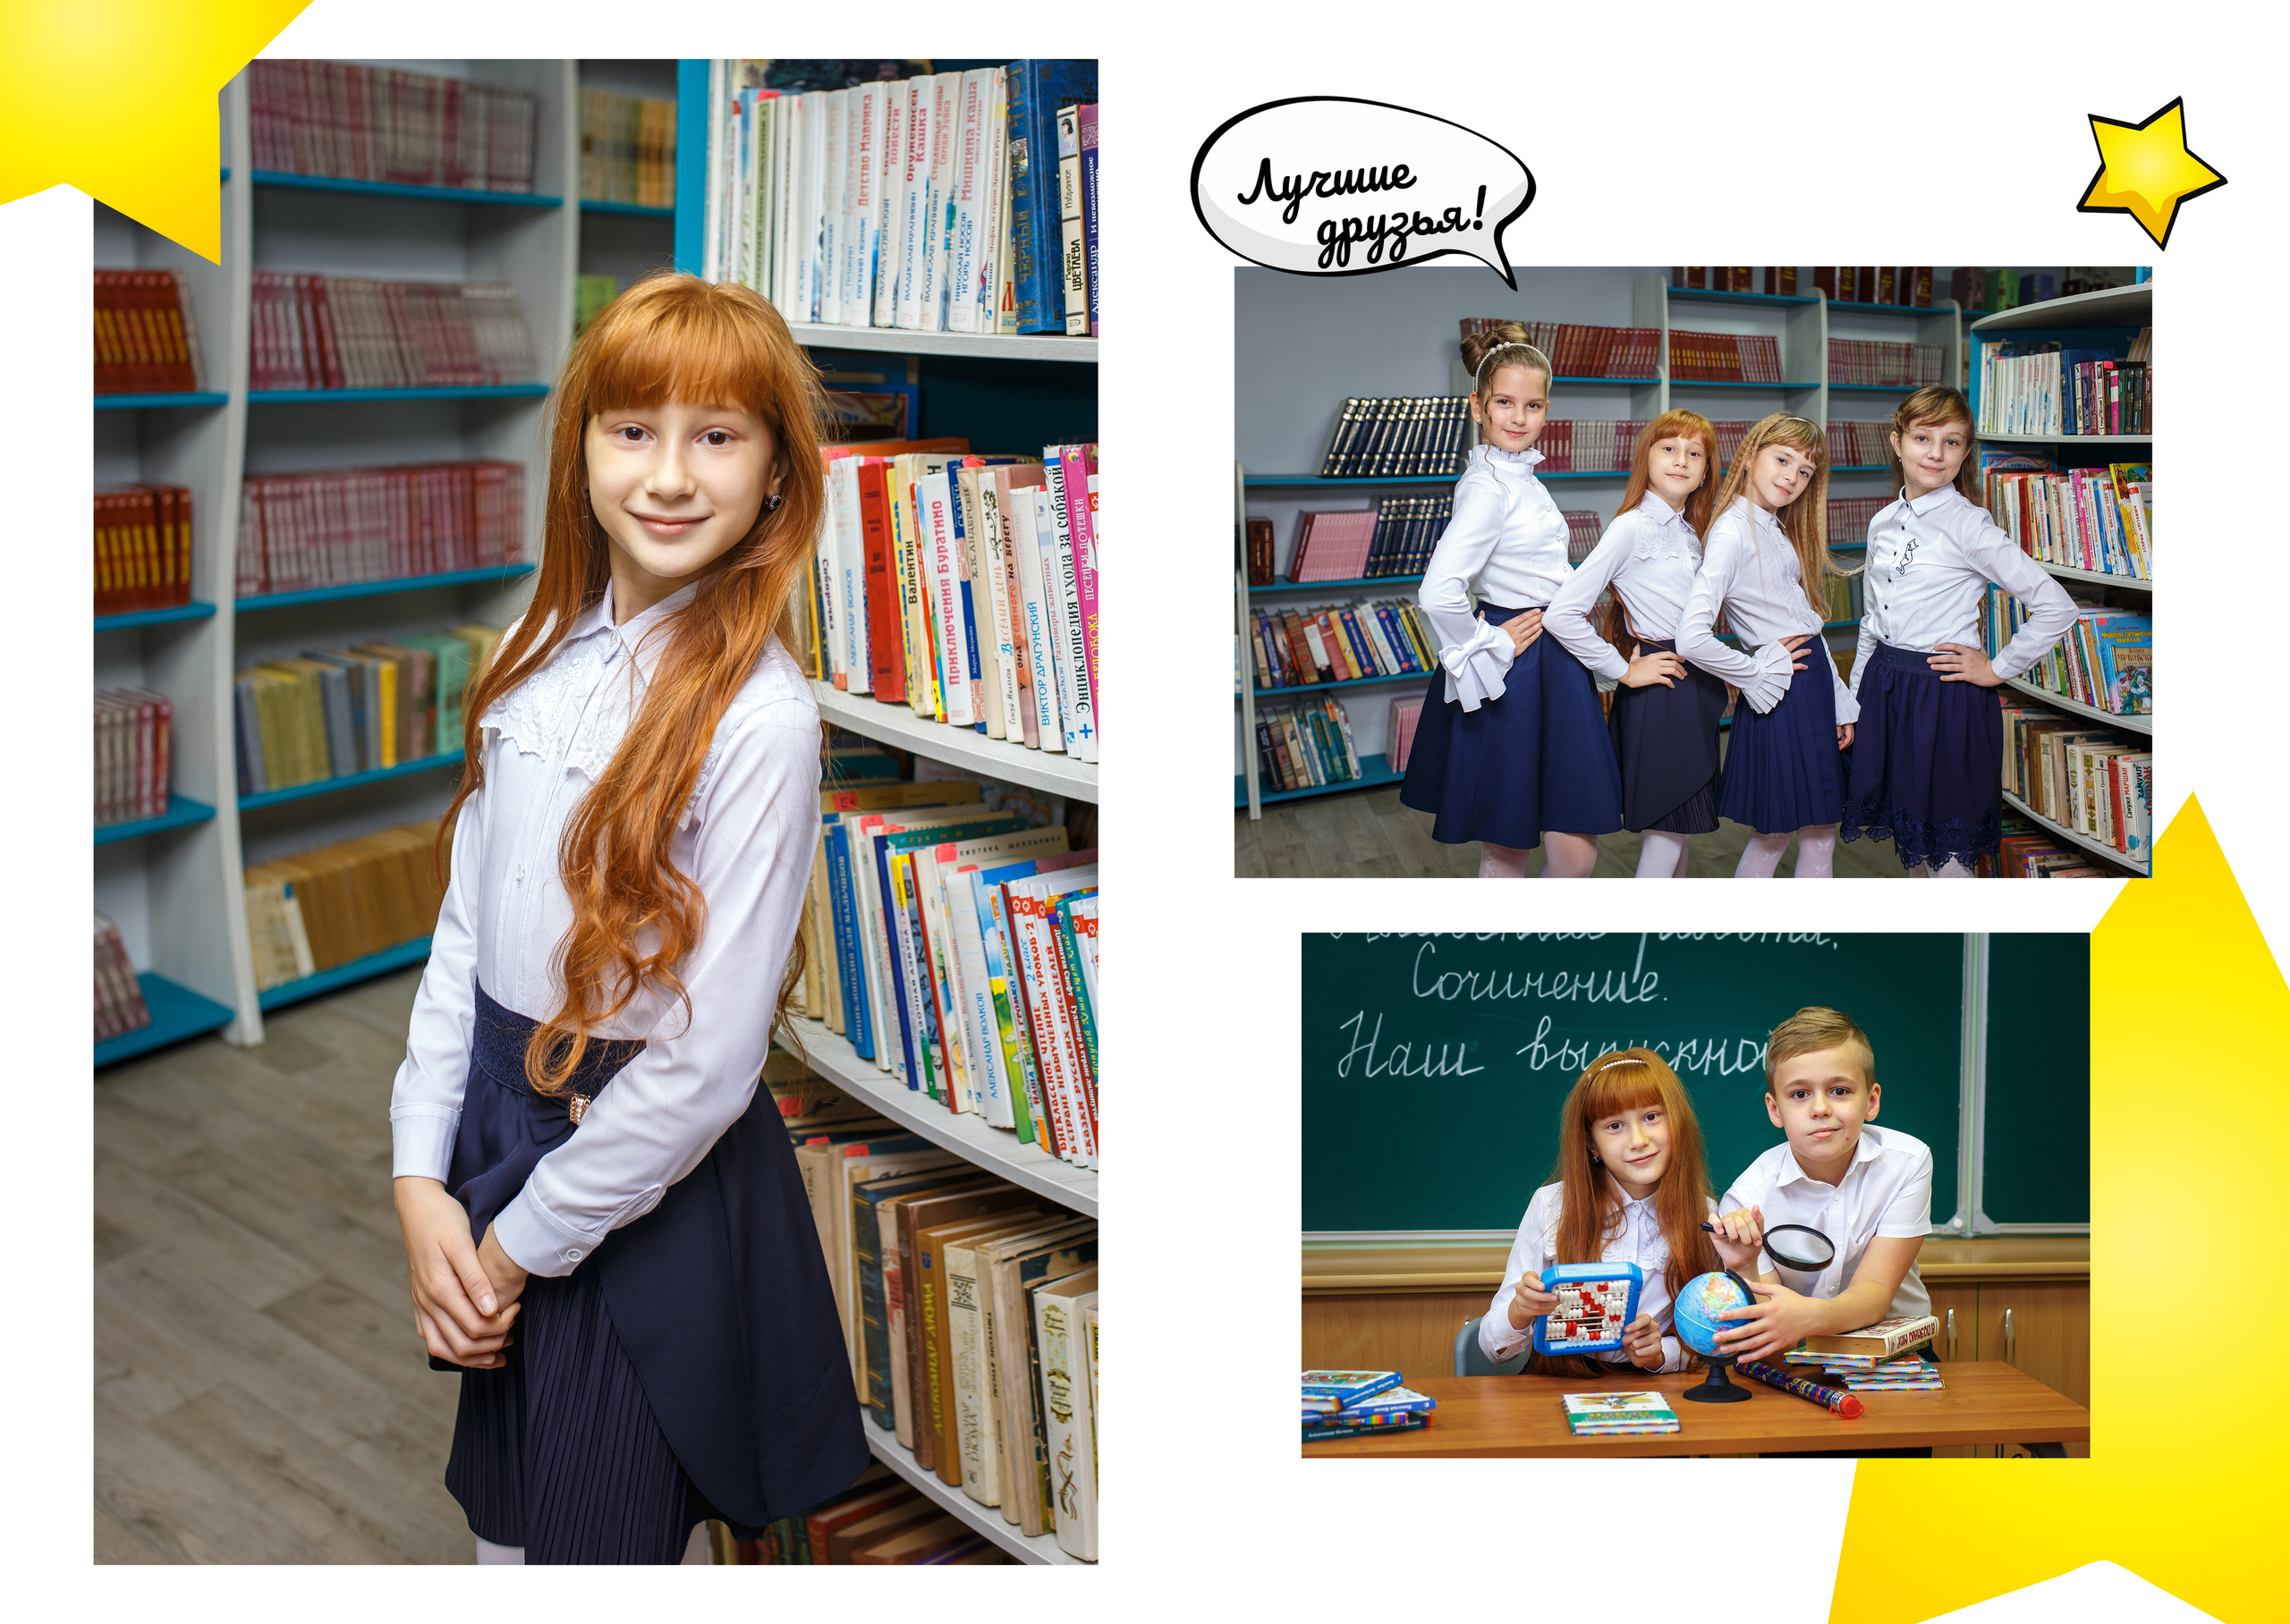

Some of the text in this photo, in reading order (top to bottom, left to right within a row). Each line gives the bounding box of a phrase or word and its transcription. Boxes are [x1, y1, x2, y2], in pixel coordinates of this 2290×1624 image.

[858, 94, 873, 207] Детство Маврика
[889, 108, 901, 165] повести
[906, 89, 919, 182] Оруженосец
[916, 107, 927, 163] Кашка
[930, 85, 944, 180] Стеклянные тайны
[961, 80, 978, 201] Мишкина каша
[1064, 168, 1073, 209] Избранное
[1088, 156, 1097, 224] невозможное
[878, 199, 890, 299] ЭДУАРД УСПЕНСКИЙ
[903, 191, 917, 301] ВЛАДИСЛАВ КРАПИВИН
[925, 189, 939, 302] ВЛАДИСЛАВ КРАПИВИН
[955, 212, 967, 301] НИКОЛАЙ НОСОВ
[962, 220, 973, 294] ИГОРЬ НОСОВ
[1015, 208, 1033, 285] ЧЕРНЫЙ
[1070, 238, 1083, 292] ЦВЕТАЕВА
[1089, 244, 1098, 314] Александр
[953, 483, 963, 528] СКАЗКИ
[963, 487, 979, 579] Х. К. АНДЕРСЕН
[2133, 504, 2142, 531] ХОТТАБЫЧ
[904, 540, 918, 605] Валентин
[993, 565, 1006, 596] ДЕНЬ
[1074, 498, 1094, 600] ПЕСЕНКИ-ПОТЕШКИ
[822, 558, 835, 630] Сибирочка
[844, 568, 857, 667] АЛЕКСАНДР ВОЛКОВ
[931, 500, 961, 686] Приключения Буратино
[1042, 557, 1062, 662] Разговоры животных
[1048, 466, 1090, 714] Энциклопедия ухода за собакой
[971, 649, 979, 673] Марья
[1027, 601, 1045, 678] ДРАГУНСКИЙ
[1038, 679, 1050, 726] ВИКТОР
[1056, 666, 1071, 721] Н. Сладков
[2121, 766, 2133, 819] Самуил МАРШАК
[2135, 766, 2144, 798] САМУИЛ
[959, 834, 1062, 857] ЛИОТЕКА ШКОЛЬНИКА
[837, 856, 852, 924] МАЛЬЧИКОВ
[903, 928, 915, 976] АЗБУКА
[1020, 939, 1036, 982] 2 класс
[1054, 928, 1073, 997] Джонатан Свифт
[1412, 941, 1670, 1003] Сочинение.
[847, 952, 863, 1043] ЭНЦИКЛОПЕДИЯ
[1010, 980, 1024, 1026] ГРОМКО
[1062, 934, 1098, 1076] Попугай Кеша ищет клад
[975, 992, 998, 1099] АЛЕКСАНДР ВОЛКОВ
[1020, 1030, 1031, 1066] ТАНЯ
[1039, 990, 1064, 1088] НЕВЫУЧЕННЫХ
[1045, 945, 1093, 1156] СКАЗКИ РУССКИХ ПИСАТЕЛЕЙ
[1071, 1004, 1082, 1043] Гулливер
[1081, 1048, 1090, 1077] стране
[1337, 1010, 1484, 1079] Наш
[1028, 1070, 1039, 1105] НАША
[1031, 1005, 1067, 1151] ВНЕКЛАССНОЕ ЧТЕНИЕ
[1059, 1091, 1075, 1142] СТРАНЕ
[922, 1282, 944, 1438] АЛЕКСАНДР ДЮМА
[1896, 1333, 1908, 1349] МИР
[1908, 1324, 1930, 1344] ПОЗНАЮ
[990, 1361, 998, 1399] ЛЕСНАЯ
